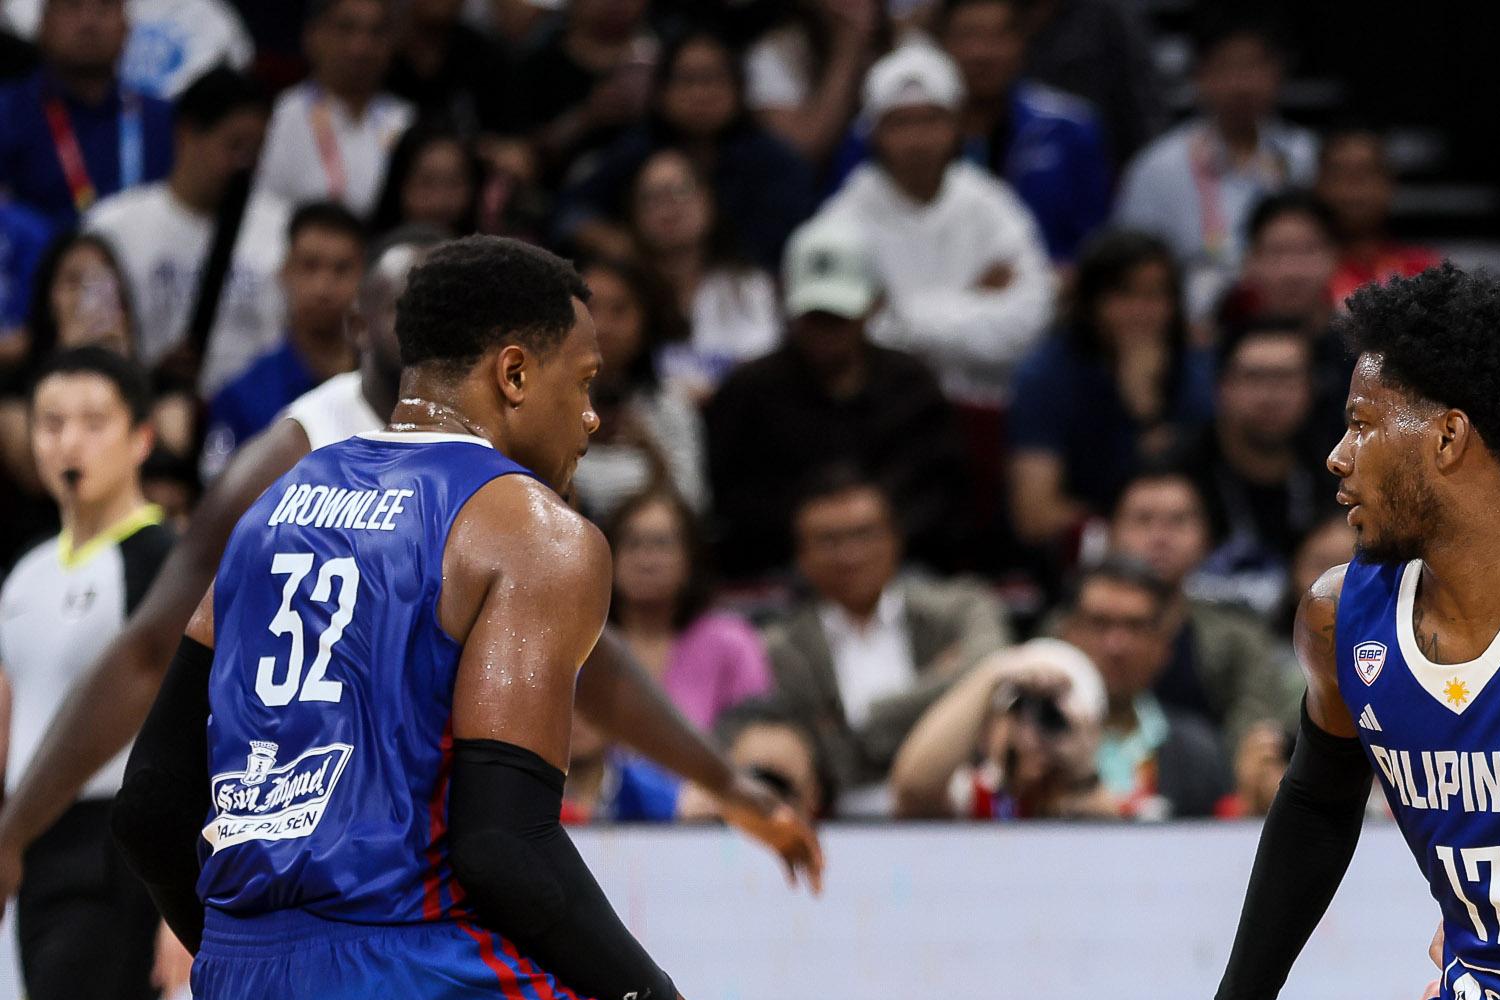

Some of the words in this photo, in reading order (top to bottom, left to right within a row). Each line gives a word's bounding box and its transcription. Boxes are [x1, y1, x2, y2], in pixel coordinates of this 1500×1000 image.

[254, 552, 360, 707] 32
[217, 822, 255, 841] ALE
[255, 810, 318, 834] PILSEN
